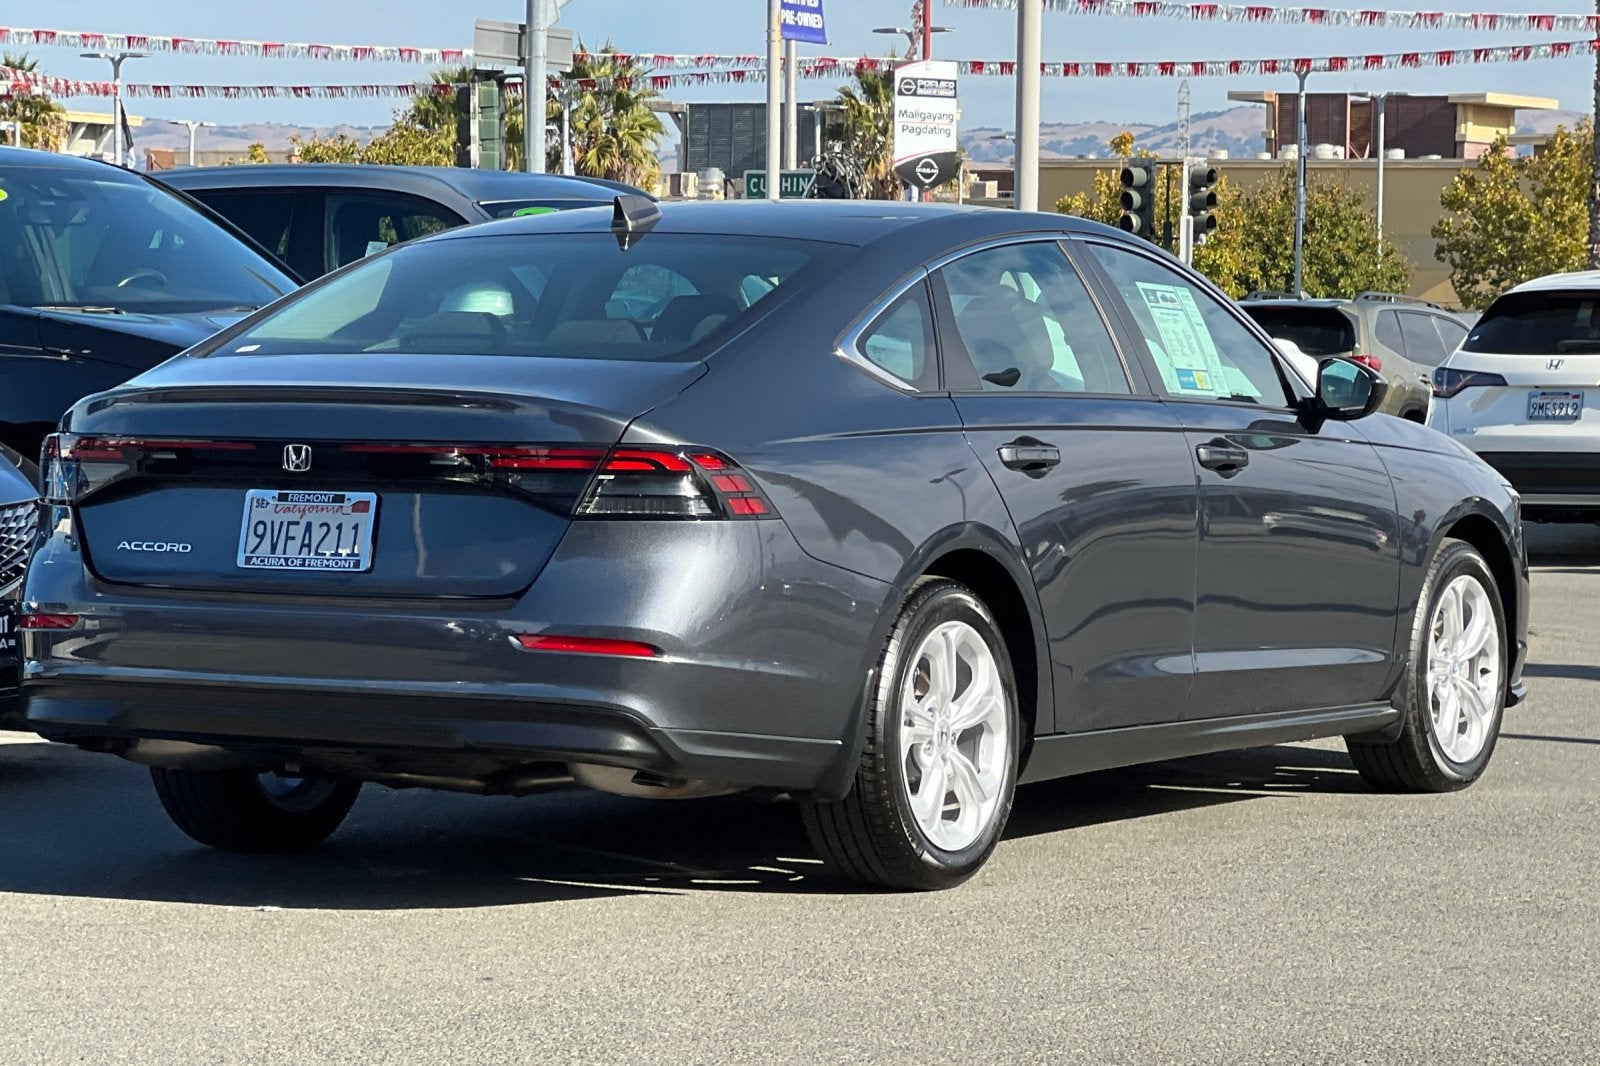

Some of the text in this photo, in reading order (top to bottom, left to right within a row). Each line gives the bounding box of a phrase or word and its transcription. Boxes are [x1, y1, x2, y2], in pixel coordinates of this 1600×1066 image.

[781, 9, 823, 29] PRE-OWNED
[898, 109, 954, 123] Maligayang
[901, 124, 951, 138] Pagdating
[749, 177, 809, 193] CUHIN
[1531, 402, 1579, 416] 9MES919
[288, 494, 335, 503] FREMONT
[250, 520, 360, 557] 9VFA211
[117, 541, 192, 553] ACCORD
[249, 557, 356, 569] ACURA OF FREMONT
